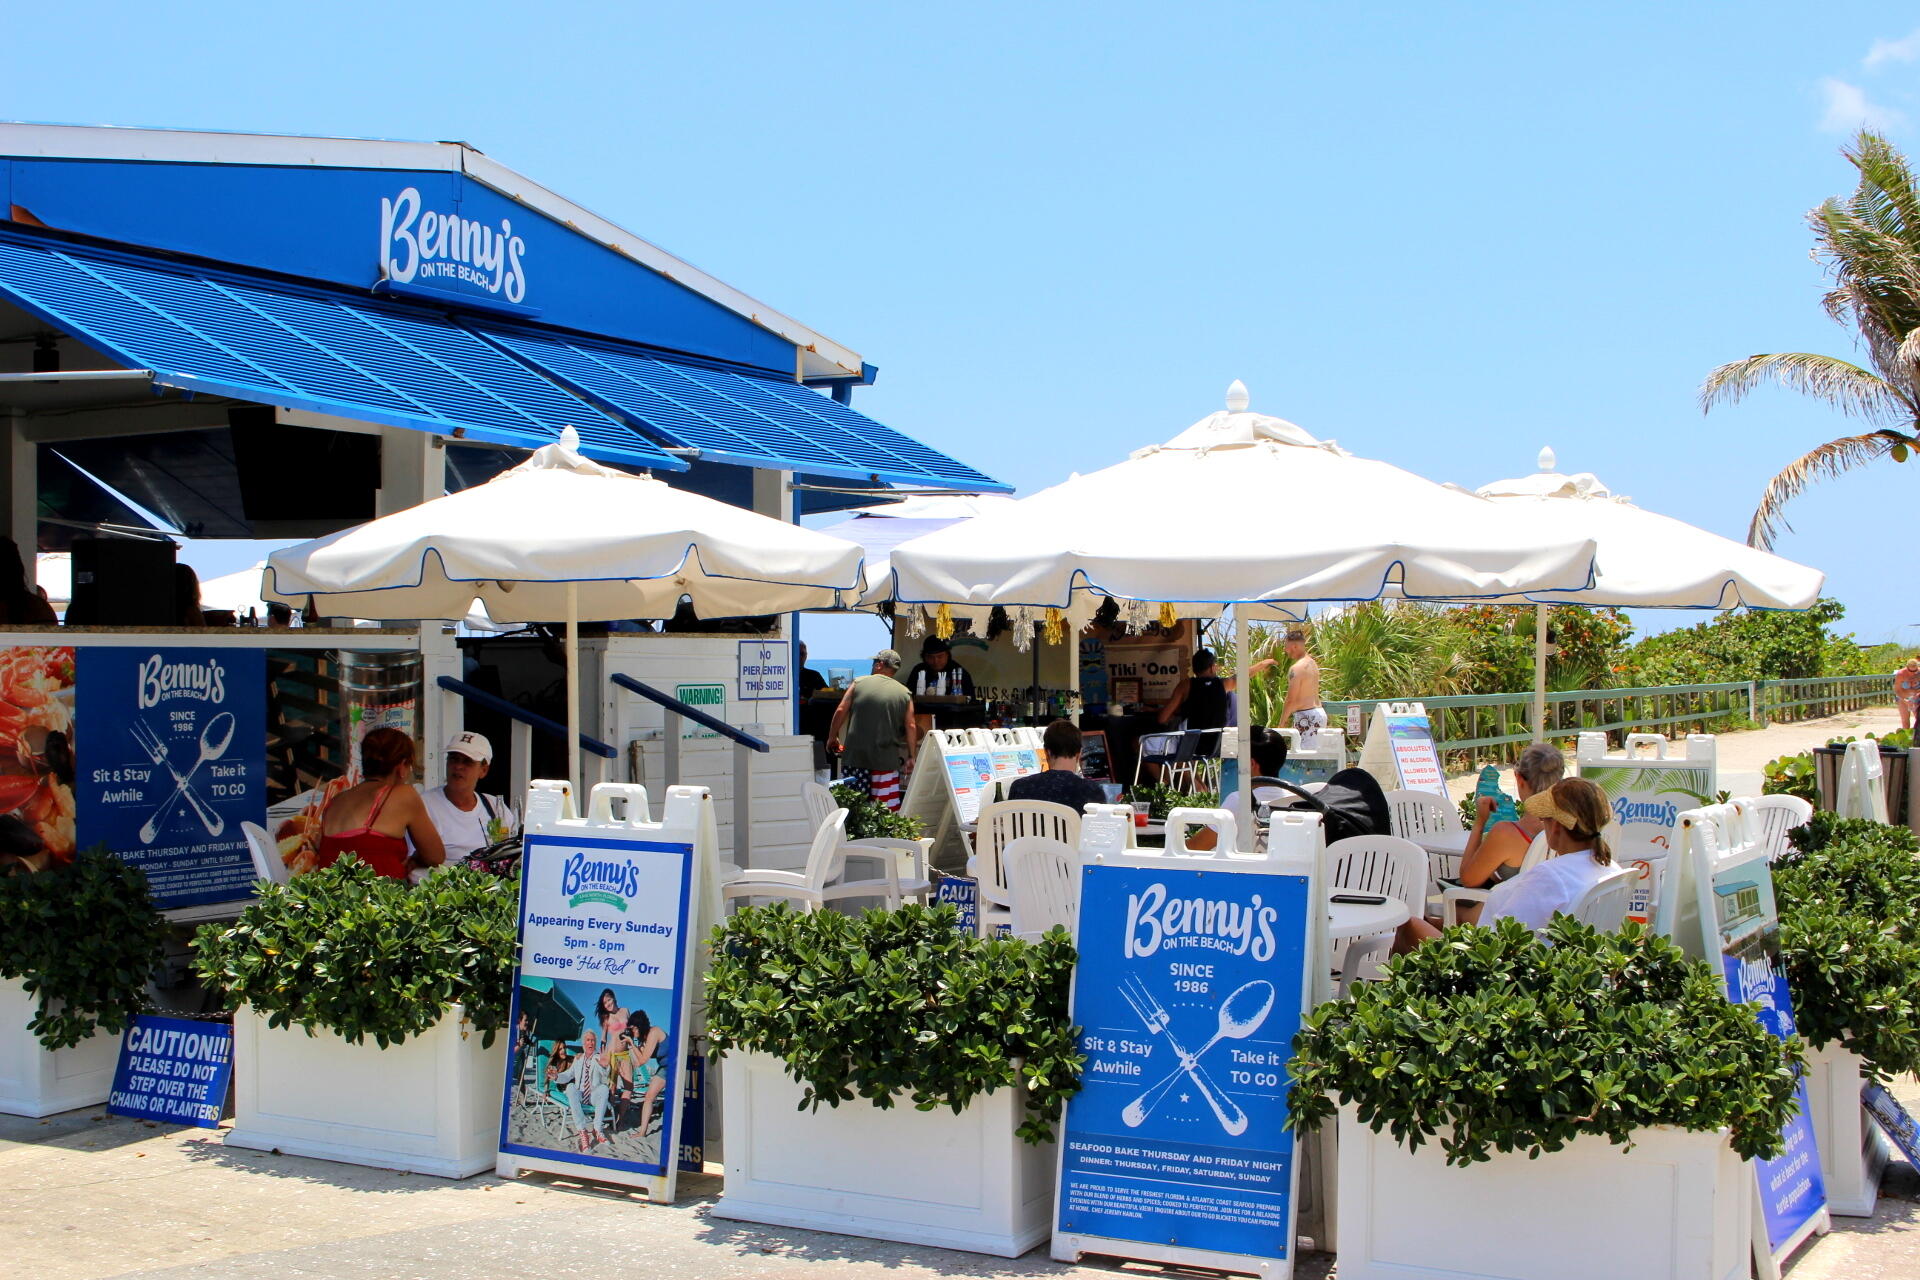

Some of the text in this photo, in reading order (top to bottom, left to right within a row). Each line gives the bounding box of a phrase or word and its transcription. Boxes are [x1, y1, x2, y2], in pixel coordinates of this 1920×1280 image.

[381, 187, 525, 303] Benny's
[421, 263, 489, 290] ON THE BEACH
[760, 650, 771, 660] NO
[743, 665, 786, 676] PIER ENTRY
[1109, 662, 1136, 676] Tiki
[138, 654, 225, 710] Benny's
[746, 680, 784, 691] THIS SIDE!
[162, 689, 202, 701] ON THE BEACH
[680, 688, 723, 704] WARNING!
[170, 711, 196, 721] SINCE
[173, 723, 193, 732] 1986
[460, 734, 475, 744] H
[93, 768, 151, 783] Sit & Stay
[210, 764, 246, 778] Take it
[102, 788, 143, 803] Awhile
[212, 784, 246, 796] TO GO
[1611, 797, 1677, 827] Benny's
[123, 850, 144, 860] BAKE
[148, 846, 189, 858] THURSDAY
[191, 844, 207, 854] AND
[208, 842, 236, 852] FRIDAY
[237, 840, 249, 849] NIG
[140, 862, 167, 870] MONDAY
[172, 859, 198, 867] SUNDAY
[562, 852, 639, 898] Benny's
[600, 884, 616, 893] BEACH
[940, 884, 975, 902] CAUT
[528, 913, 673, 938] Appearing Every Sunday
[1124, 883, 1277, 962] Benny's
[564, 936, 588, 949] 5pm
[599, 939, 625, 953] 8pm
[1163, 936, 1234, 954] ON THE BEACH
[534, 953, 573, 968] George
[638, 962, 660, 974] Orr
[1170, 963, 1214, 978] SINCE
[1174, 980, 1208, 993] 1986
[127, 1026, 232, 1064] CAUTION!!!
[1084, 1036, 1152, 1058] Sit & Stay
[1231, 1049, 1279, 1065] Take it
[129, 1056, 217, 1082] PLEASE DO NOT
[1093, 1060, 1141, 1076] Awhile
[1231, 1071, 1277, 1087] TO GO
[129, 1075, 209, 1100] STEP OVER THE
[110, 1091, 220, 1121] CHAINS OR PLANTERS
[1069, 1142, 1282, 1171] SEAFOOD BAKE THURSDAY AND FRIDAY NIGHT
[1080, 1156, 1271, 1183] DINNER: THURSDAY, FRIDAY, SATURDAY, SUNDAY
[1115, 1187, 1130, 1195] SERVE
[1192, 1196, 1214, 1204] ATLANTIC
[1233, 1200, 1255, 1208] SEAFOOD
